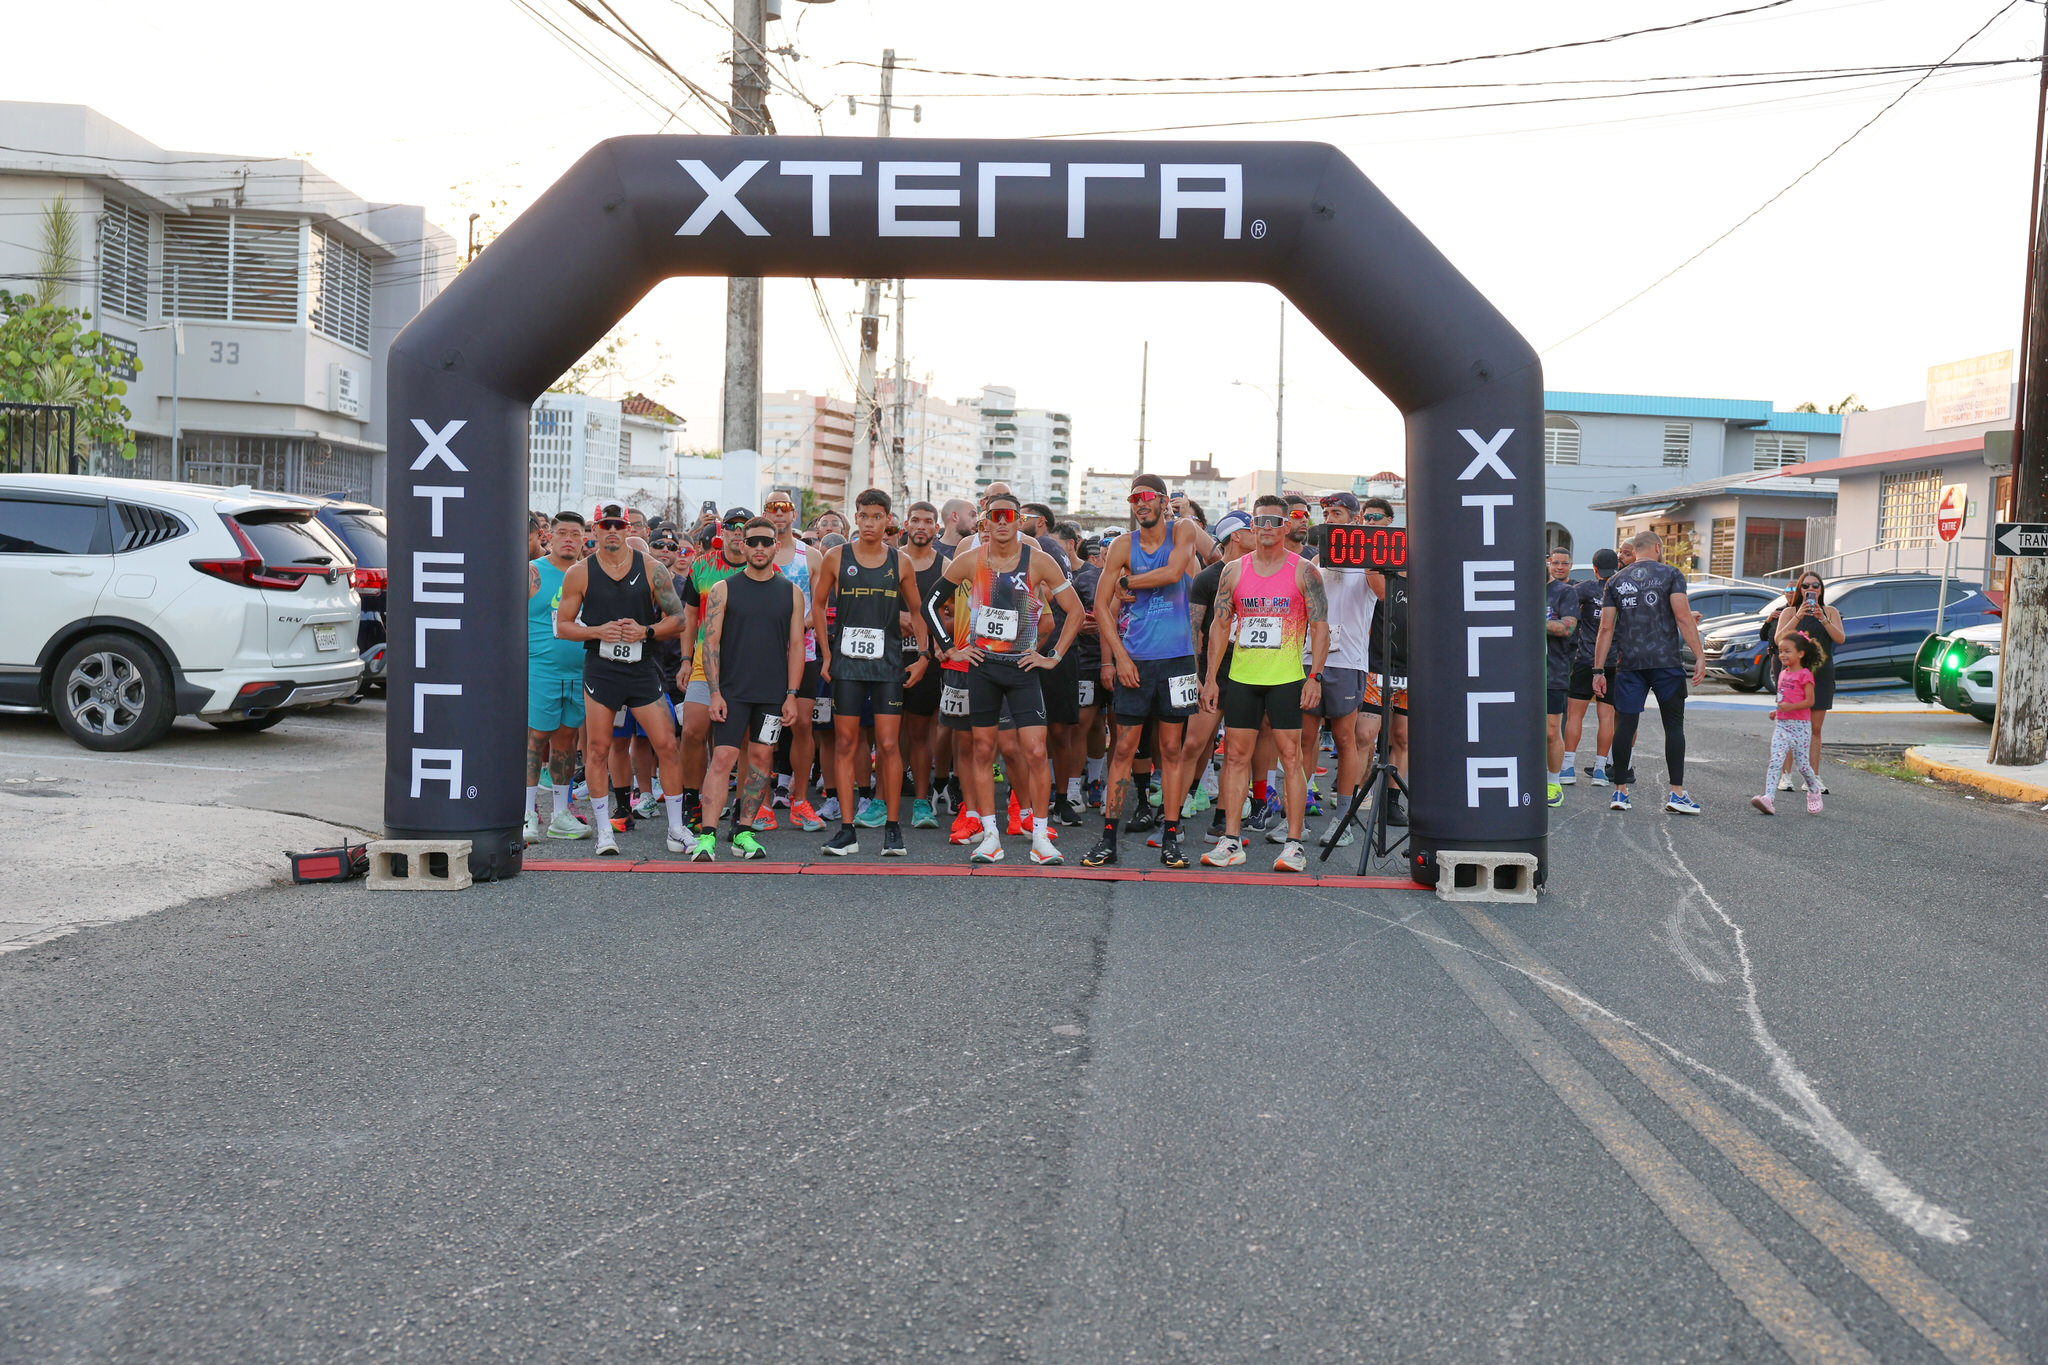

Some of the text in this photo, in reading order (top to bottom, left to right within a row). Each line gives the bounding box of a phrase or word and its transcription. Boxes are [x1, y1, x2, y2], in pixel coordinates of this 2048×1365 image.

[209, 341, 241, 365] 33
[1941, 521, 1957, 531] ENTRE
[2018, 534, 2048, 547] TRAN
[1240, 597, 1290, 608] TIME TO RUN
[987, 621, 1004, 636] 95
[1250, 630, 1268, 643] 29
[613, 644, 631, 658] 68
[850, 640, 875, 655] 158
[1180, 688, 1198, 703] 109
[944, 699, 963, 713] 171
